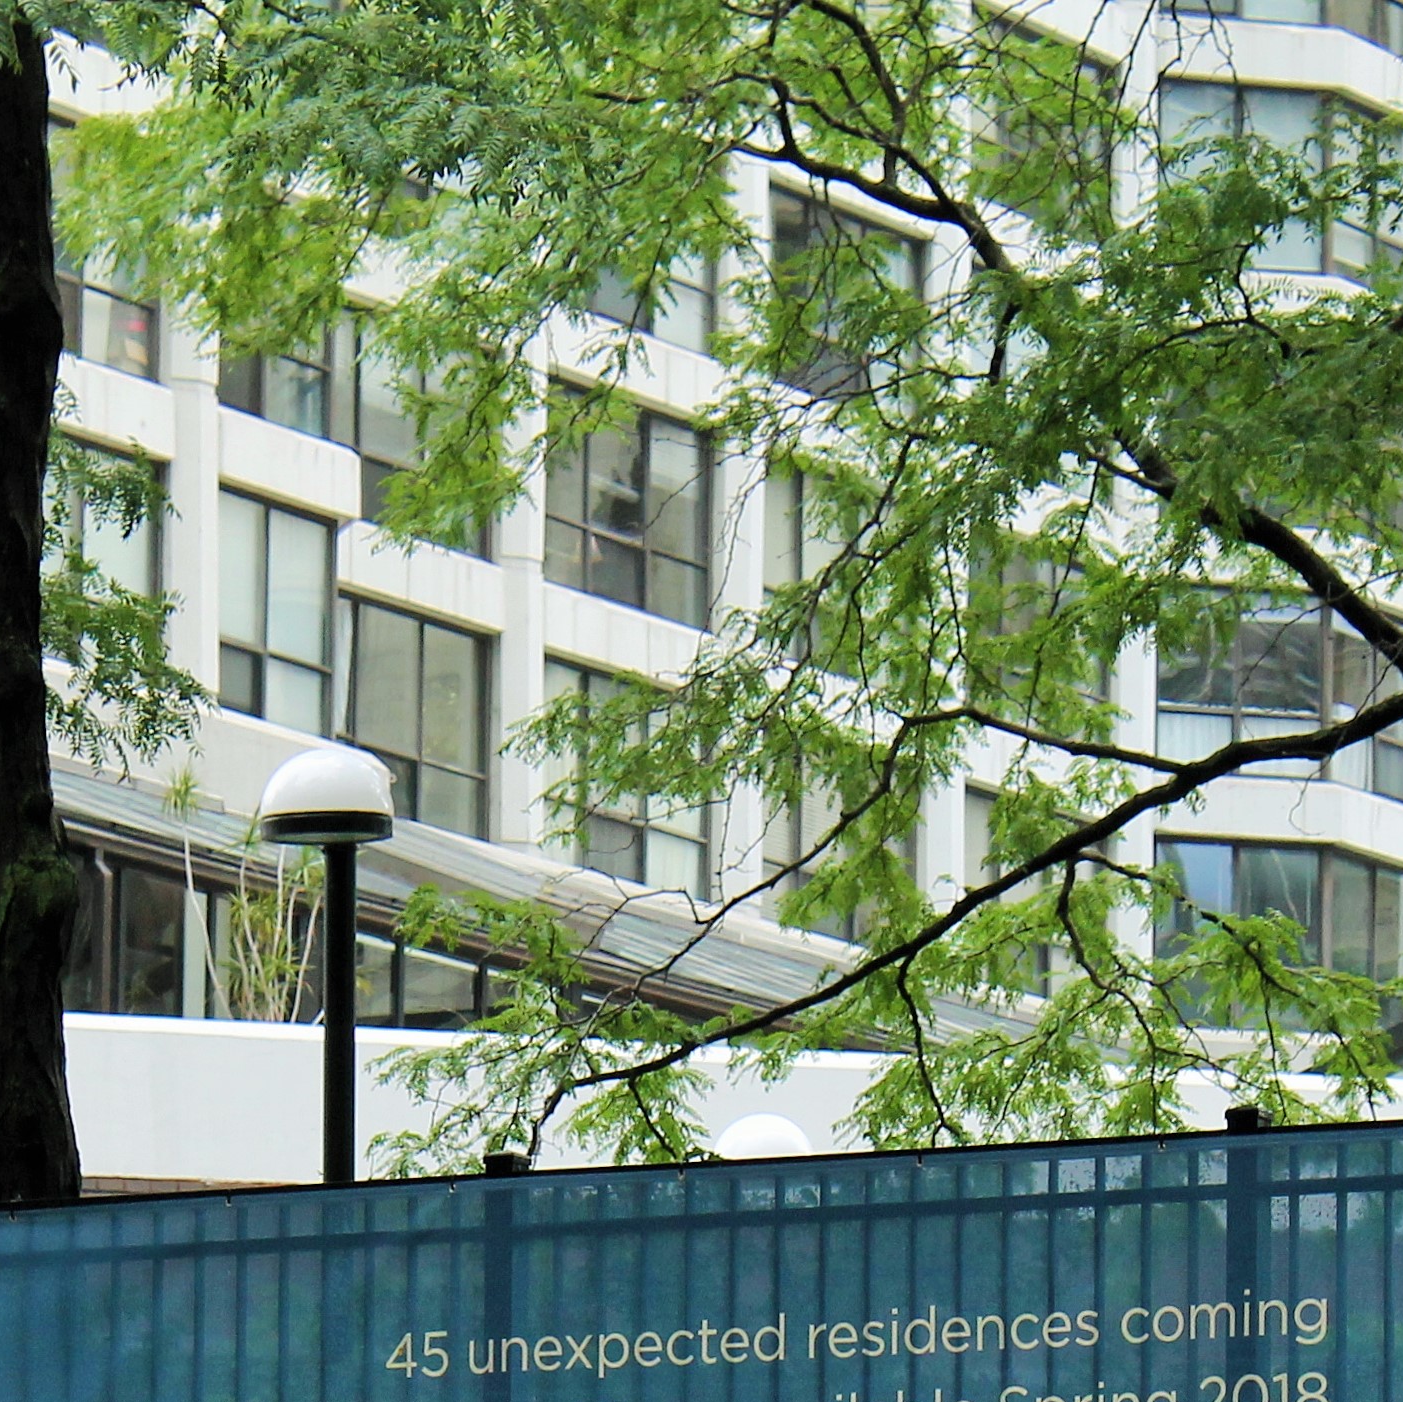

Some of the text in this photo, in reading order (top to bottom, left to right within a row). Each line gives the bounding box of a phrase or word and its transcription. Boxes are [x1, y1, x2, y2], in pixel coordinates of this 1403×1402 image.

[385, 1288, 1329, 1380] 45 unexpected residences coming
